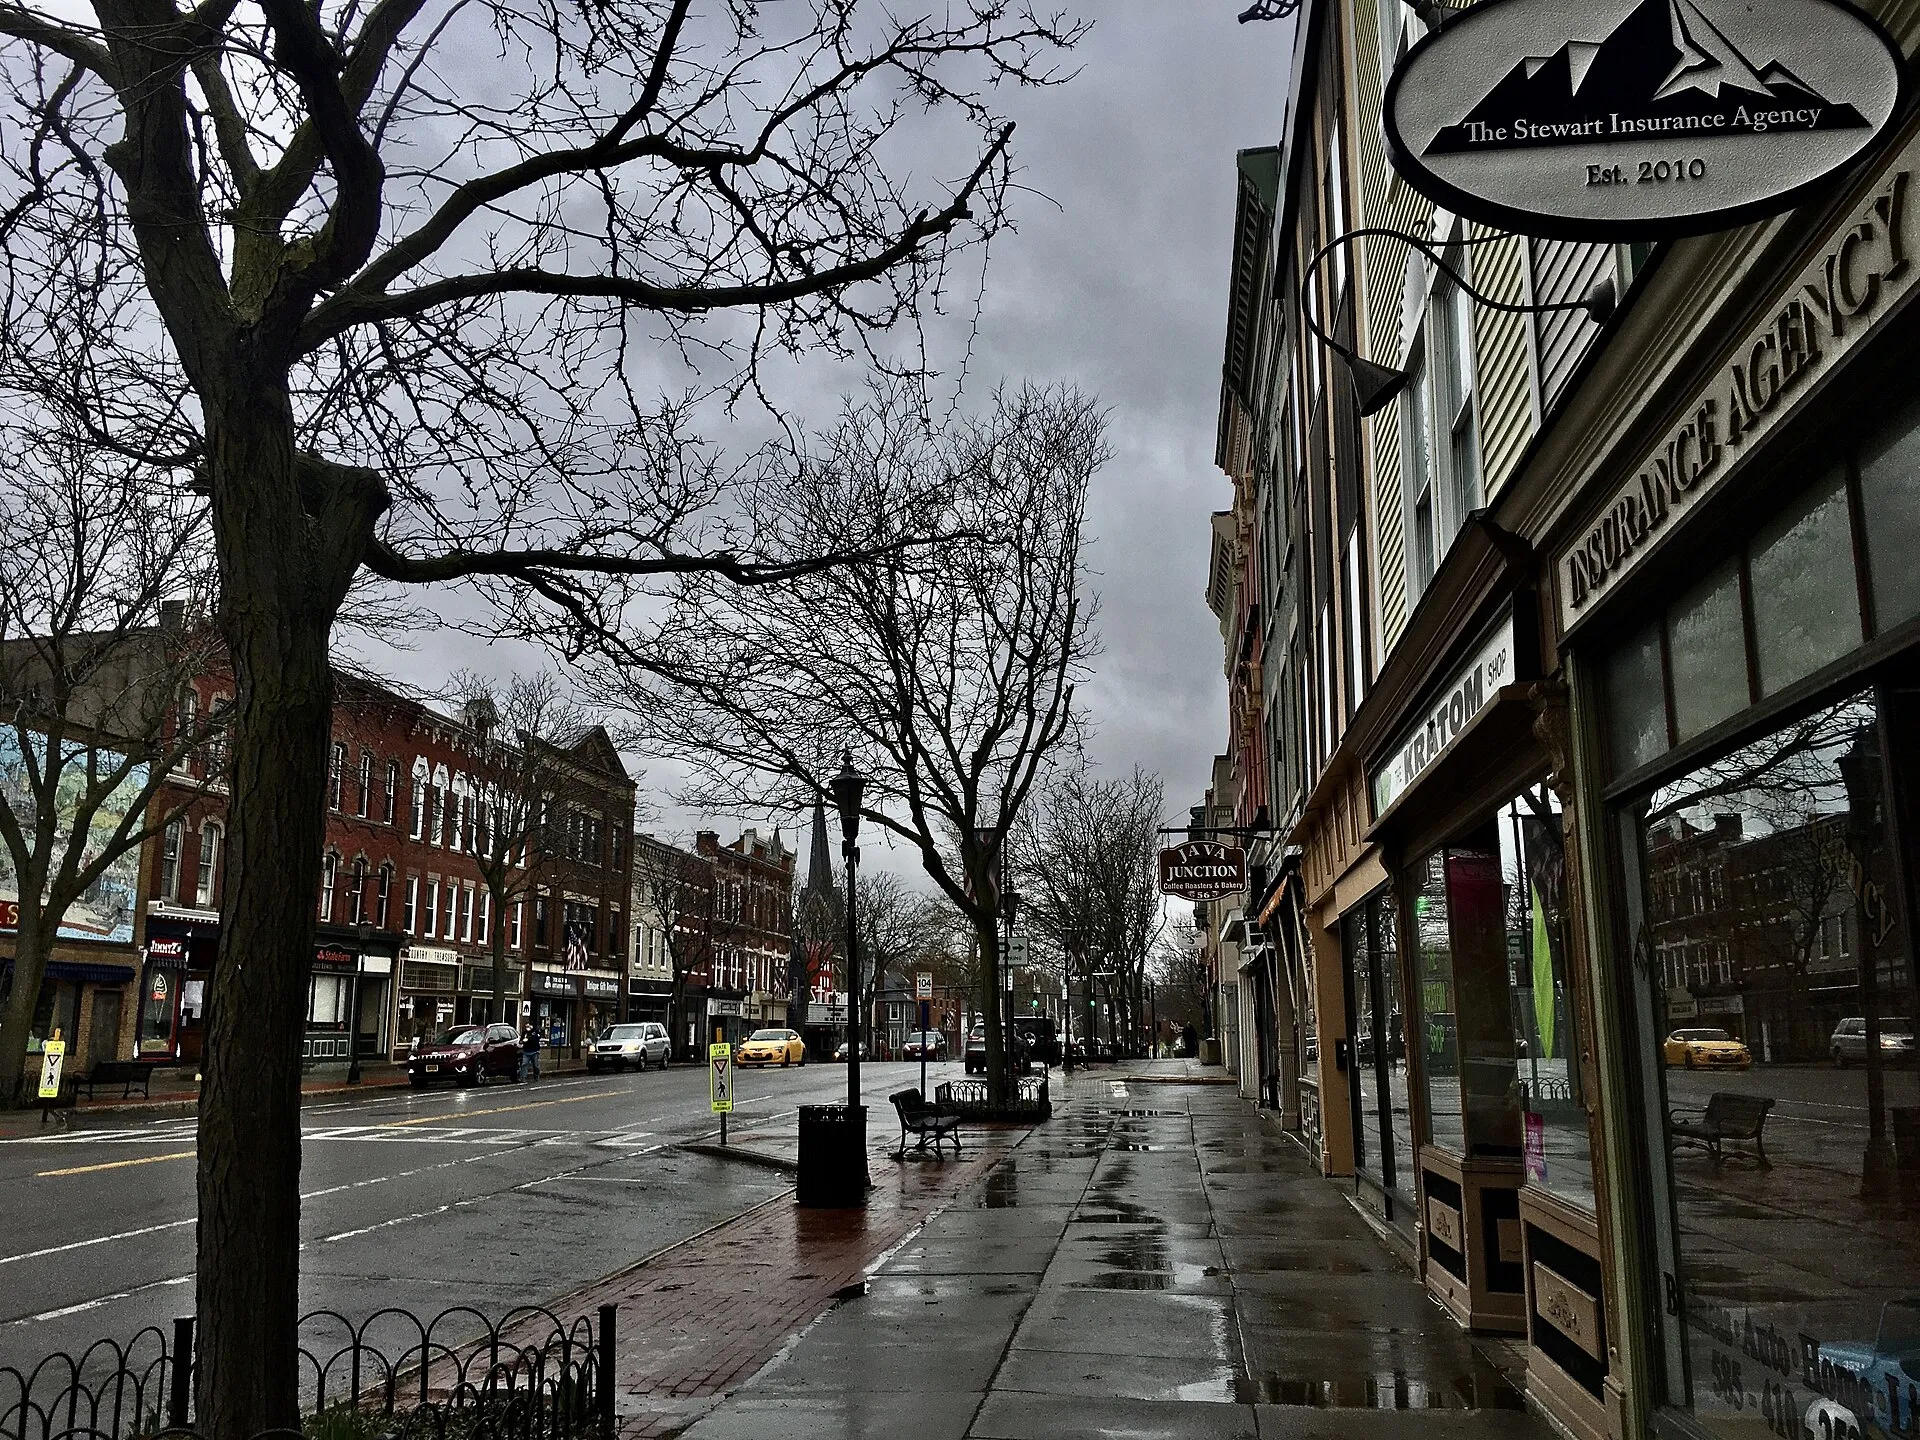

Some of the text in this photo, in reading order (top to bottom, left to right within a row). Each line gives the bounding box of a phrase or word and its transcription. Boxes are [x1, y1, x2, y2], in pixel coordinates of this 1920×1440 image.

[1463, 104, 1823, 143] The Stewart Insurance Agency
[1585, 158, 1706, 187] Est. 2010
[1569, 170, 1911, 608] INSURANCE AGENCY
[1402, 663, 1484, 785] KRATOM
[1487, 648, 1506, 686] SHOP
[1177, 844, 1227, 864] JAVA
[1163, 882, 1184, 890] Coffee
[1166, 865, 1238, 882] JUNCTION
[1196, 891, 1210, 899] 56
[1798, 1332, 1874, 1422] Home
